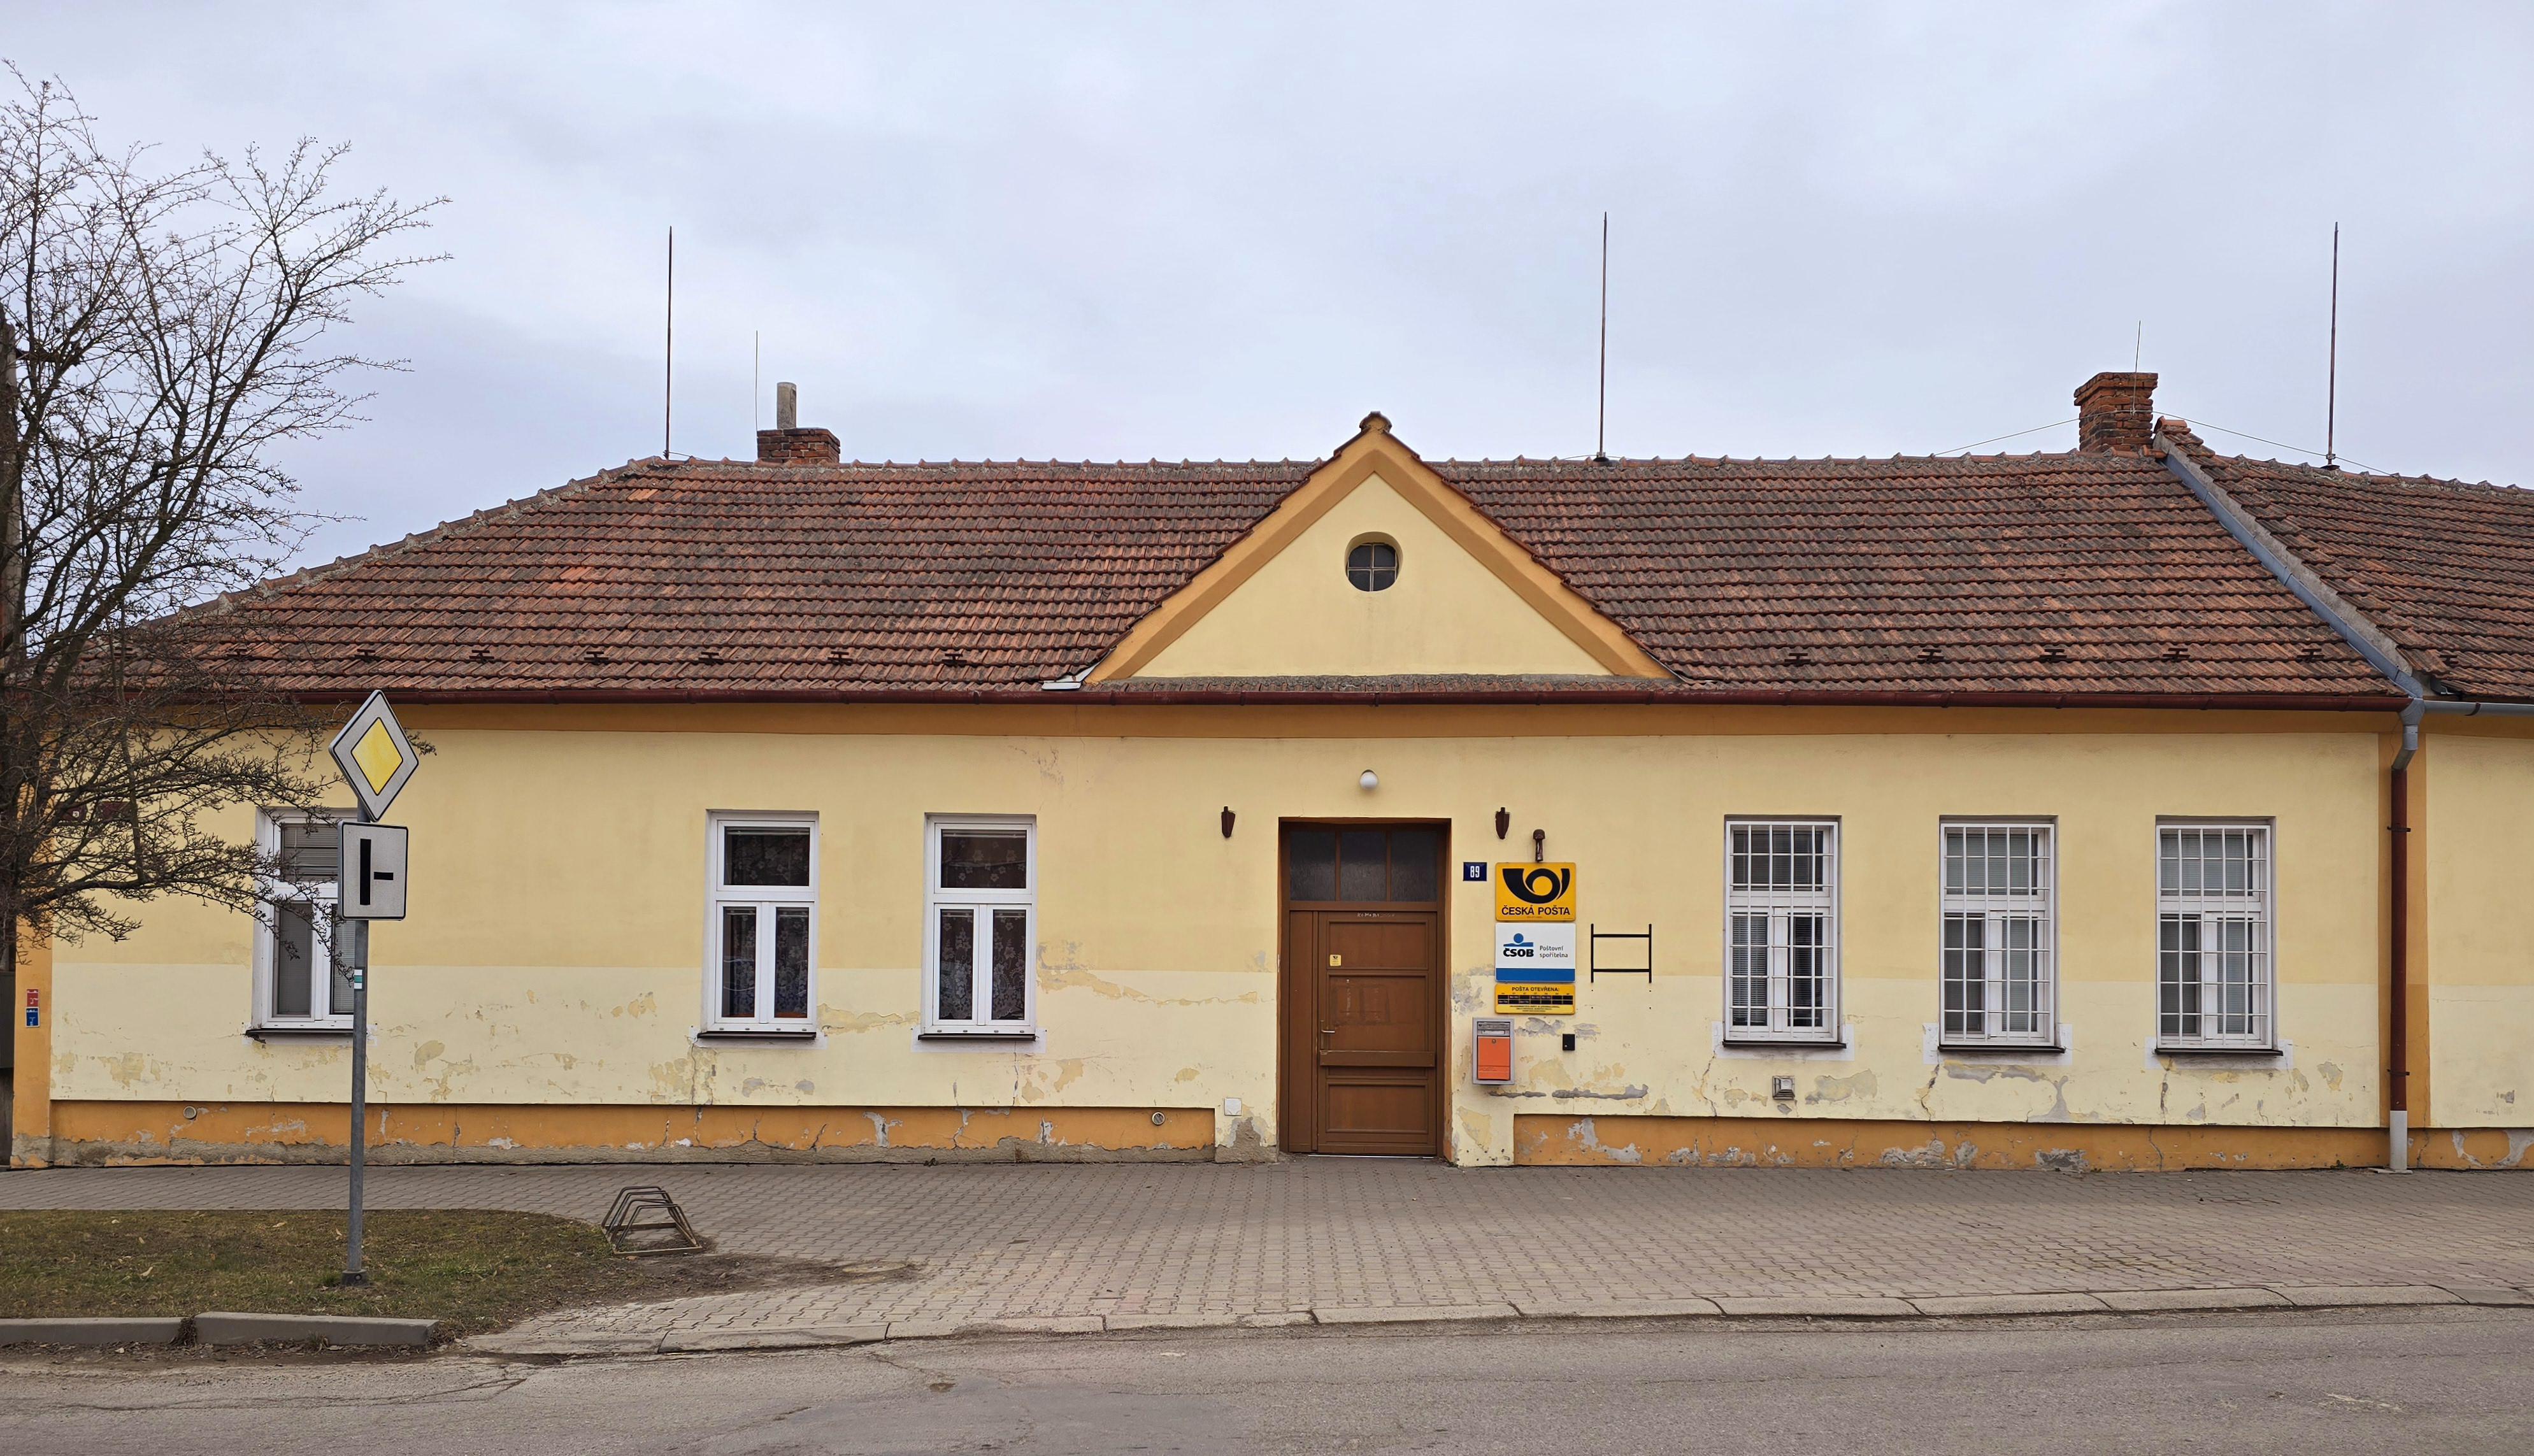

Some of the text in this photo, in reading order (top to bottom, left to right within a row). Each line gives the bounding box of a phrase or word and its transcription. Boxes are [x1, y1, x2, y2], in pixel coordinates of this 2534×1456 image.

[1470, 866, 1480, 878] 89
[1501, 904, 1570, 915] ČESKÁ POŠTA
[1503, 947, 1534, 957] ČSOB
